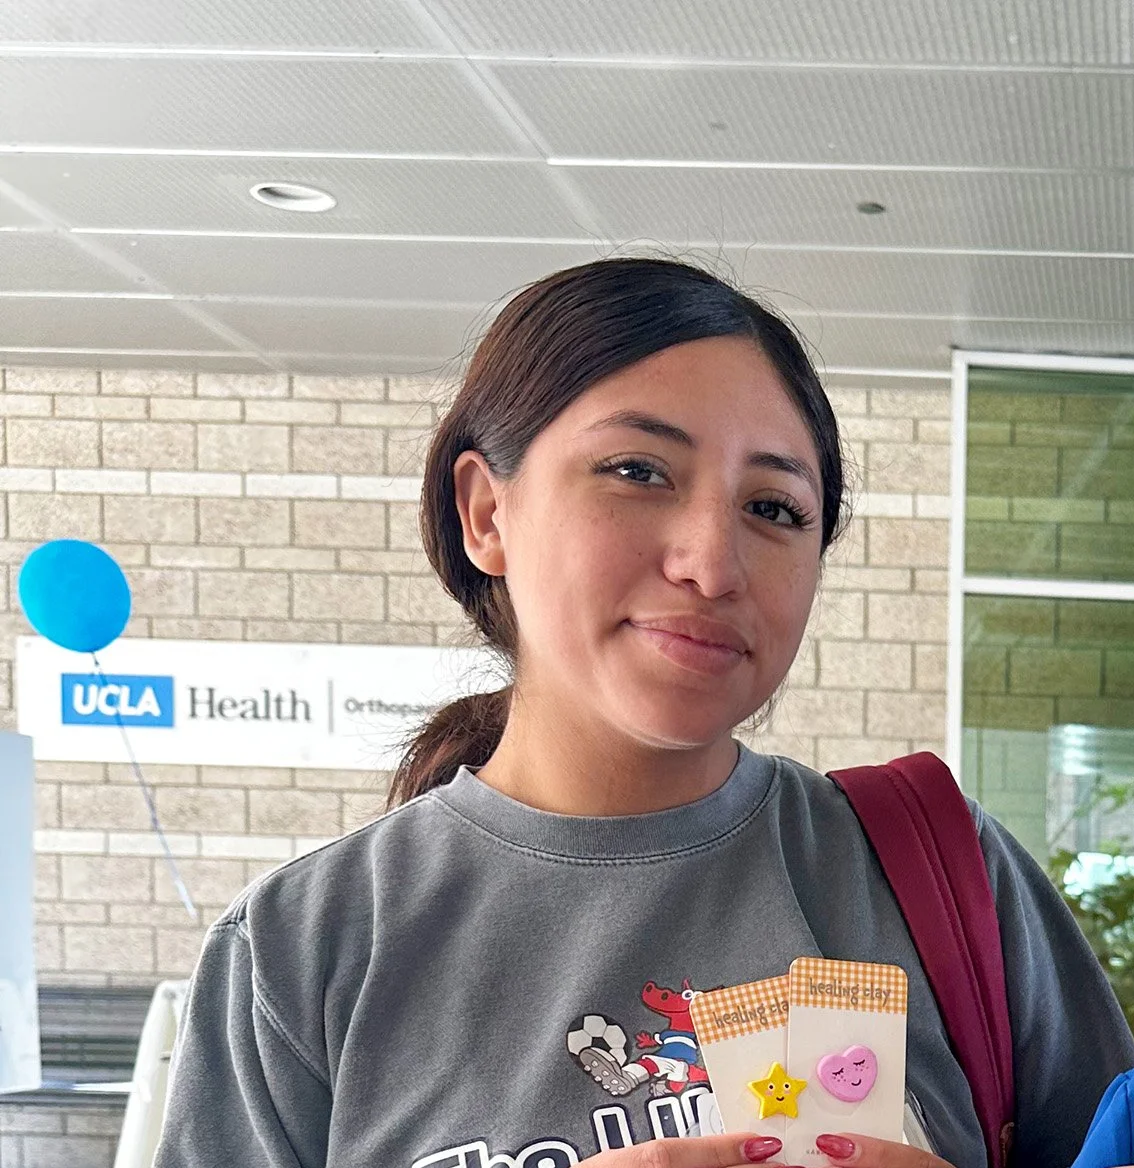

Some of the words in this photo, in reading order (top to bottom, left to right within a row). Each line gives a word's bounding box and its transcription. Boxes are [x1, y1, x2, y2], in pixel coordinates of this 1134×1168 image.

[72, 684, 161, 717] UCLA
[188, 687, 312, 722] Health
[809, 978, 859, 1006] healing
[863, 983, 891, 1007] clay
[713, 1004, 767, 1029] healing
